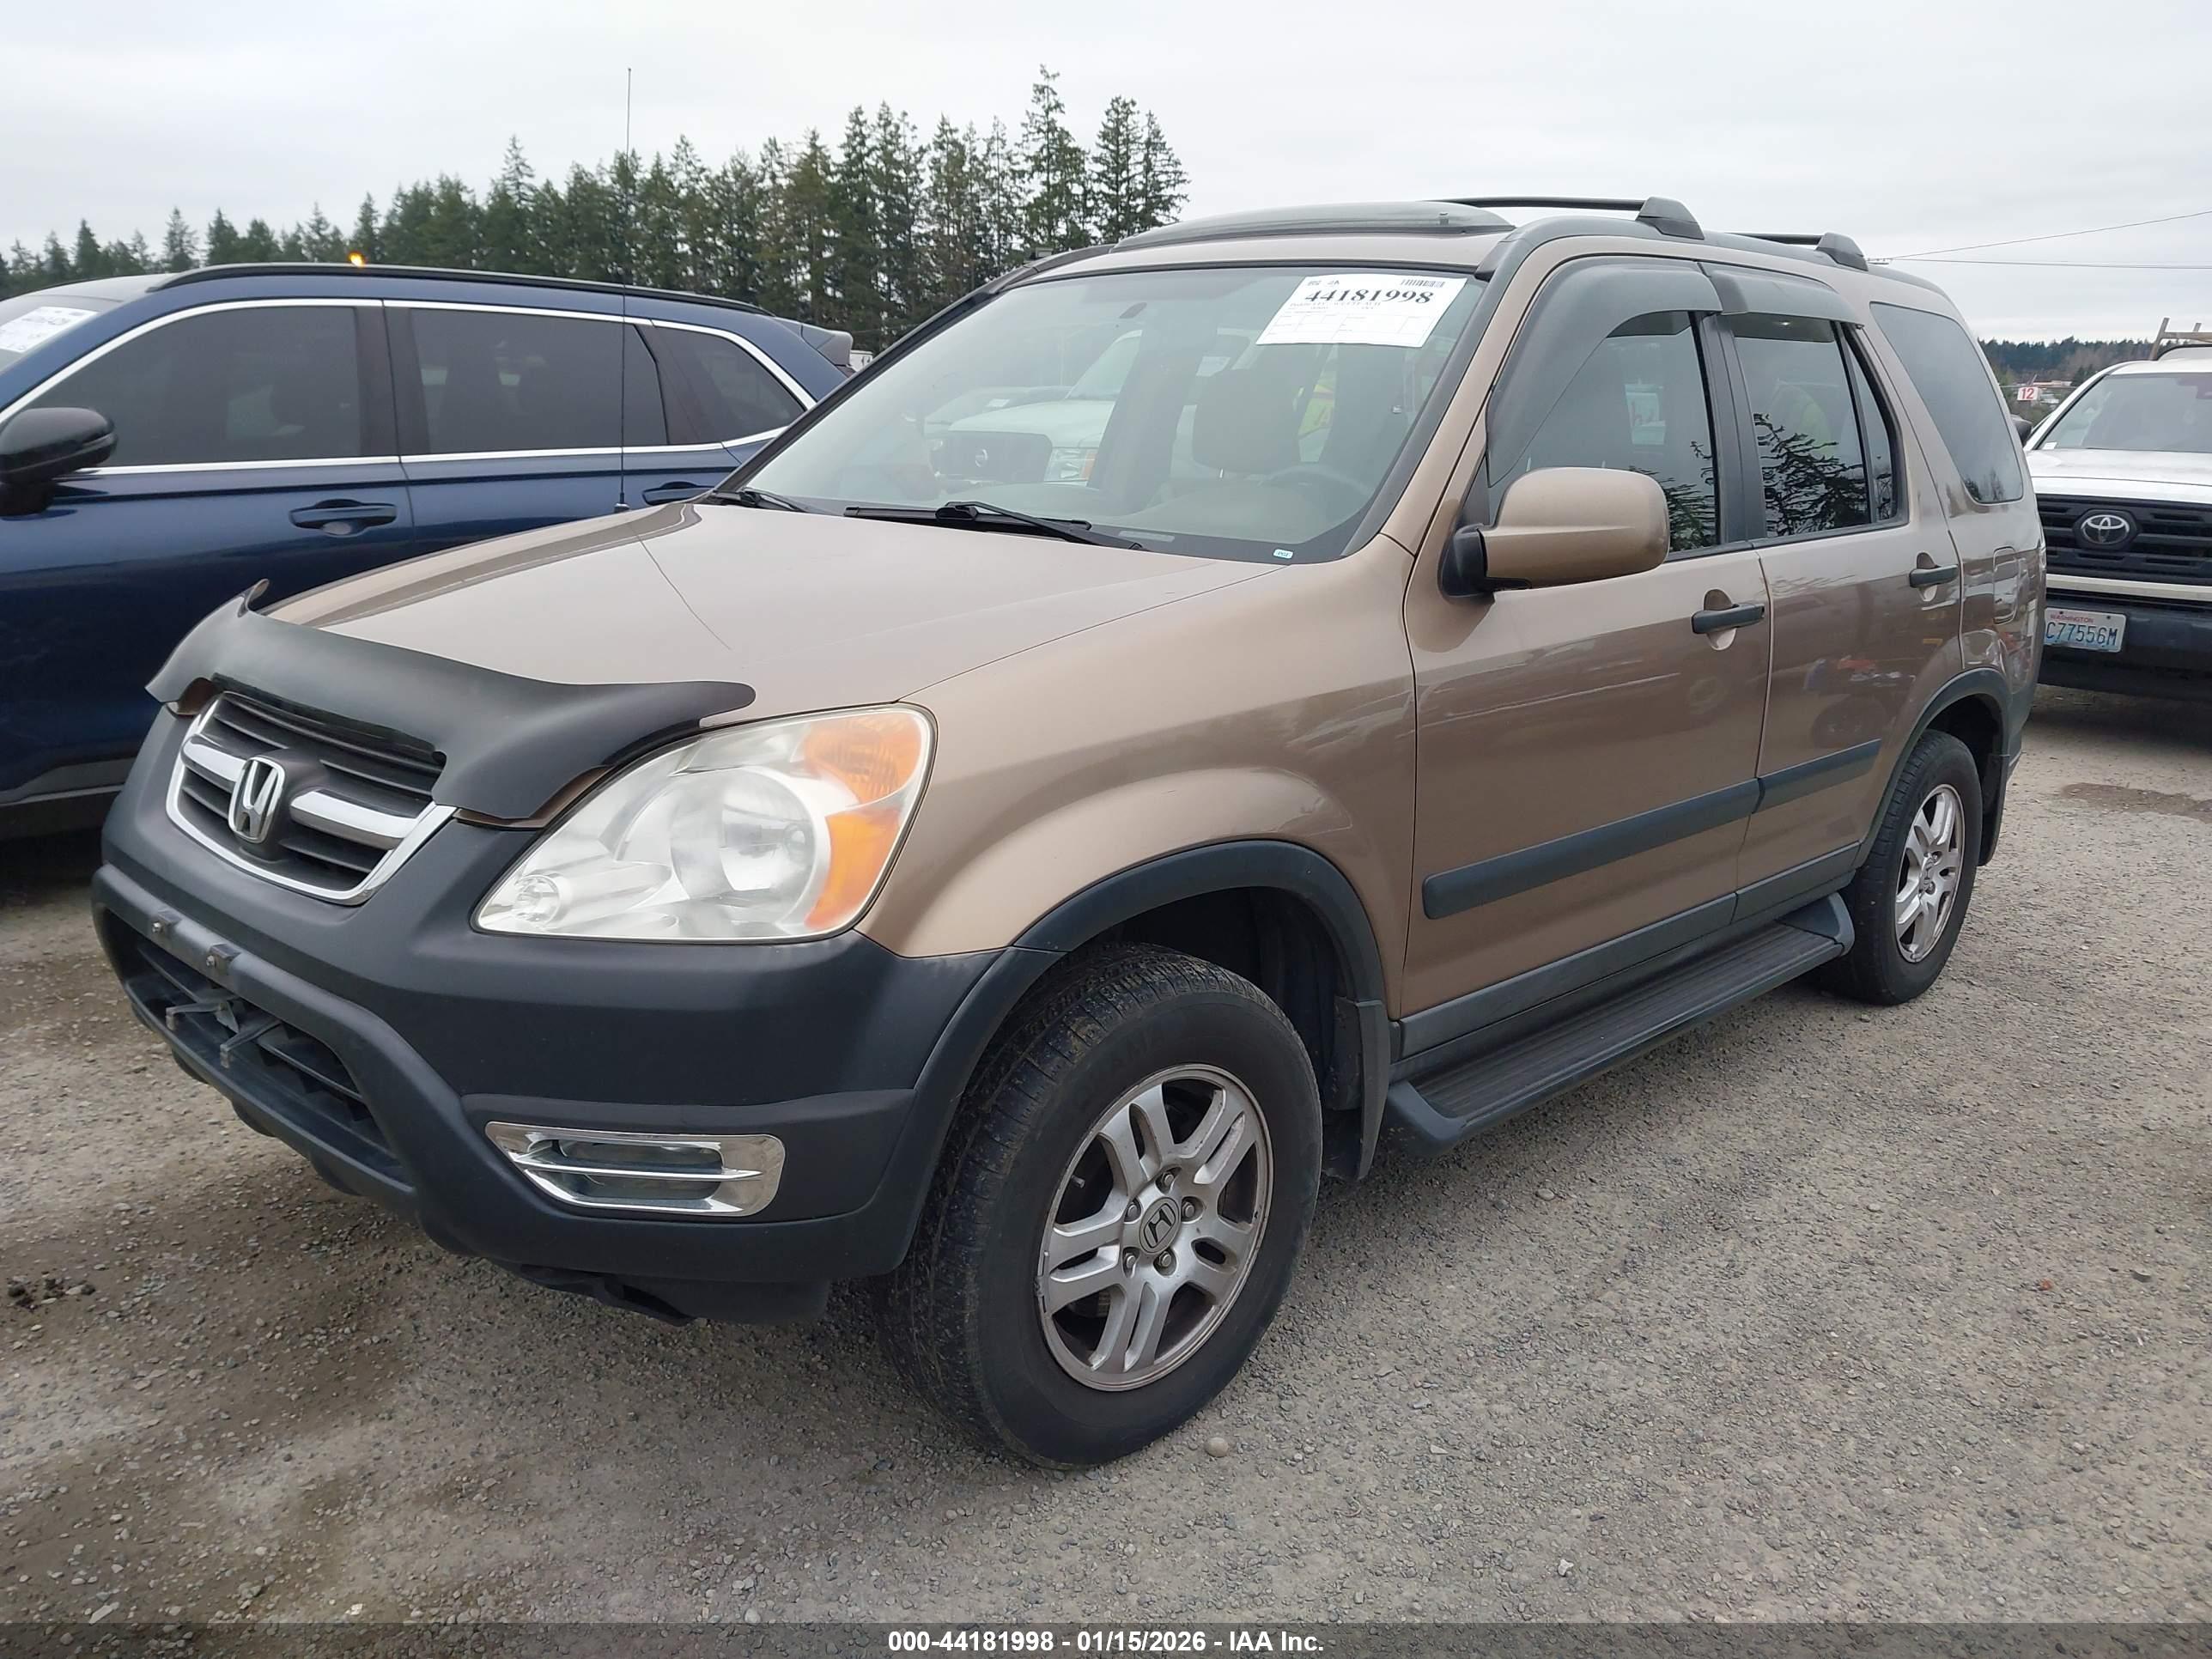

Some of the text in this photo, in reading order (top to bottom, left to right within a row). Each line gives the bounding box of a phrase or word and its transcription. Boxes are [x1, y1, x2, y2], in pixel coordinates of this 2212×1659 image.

[1304, 289, 1434, 303] 44181998
[2021, 387, 2034, 399] 12
[2045, 622, 2118, 646] C77556M
